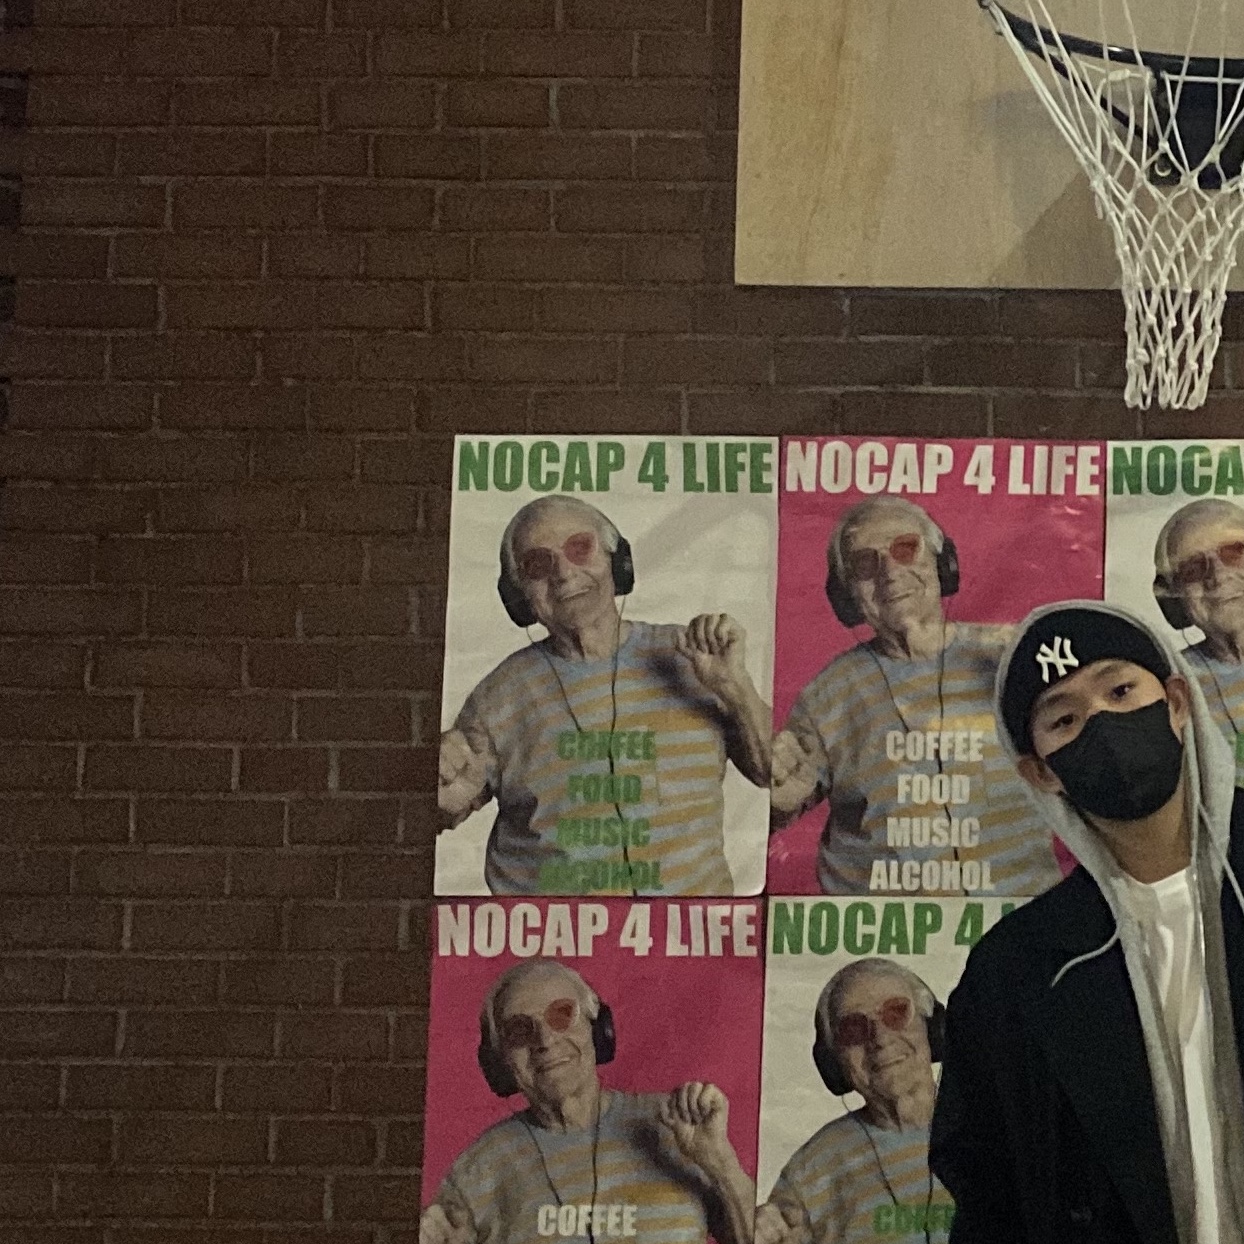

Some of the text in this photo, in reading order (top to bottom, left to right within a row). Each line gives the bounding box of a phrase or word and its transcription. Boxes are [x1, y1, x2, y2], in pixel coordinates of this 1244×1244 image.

[458, 441, 773, 493] NOCAP 4 LIFE
[785, 441, 1100, 495] NOCAP 4 LIFE
[886, 730, 983, 763] COFFEE
[568, 774, 641, 804] FOOD
[897, 774, 970, 805] FOOD
[556, 817, 650, 846] MUSIC
[886, 817, 979, 848] MUSIC
[868, 860, 995, 890] ALCOHOL
[437, 903, 758, 958] NOCAP 4 LIFE
[772, 901, 984, 955] NOCAP 4
[537, 1203, 636, 1237] COFFEE
[873, 1205, 957, 1234] COFFE
